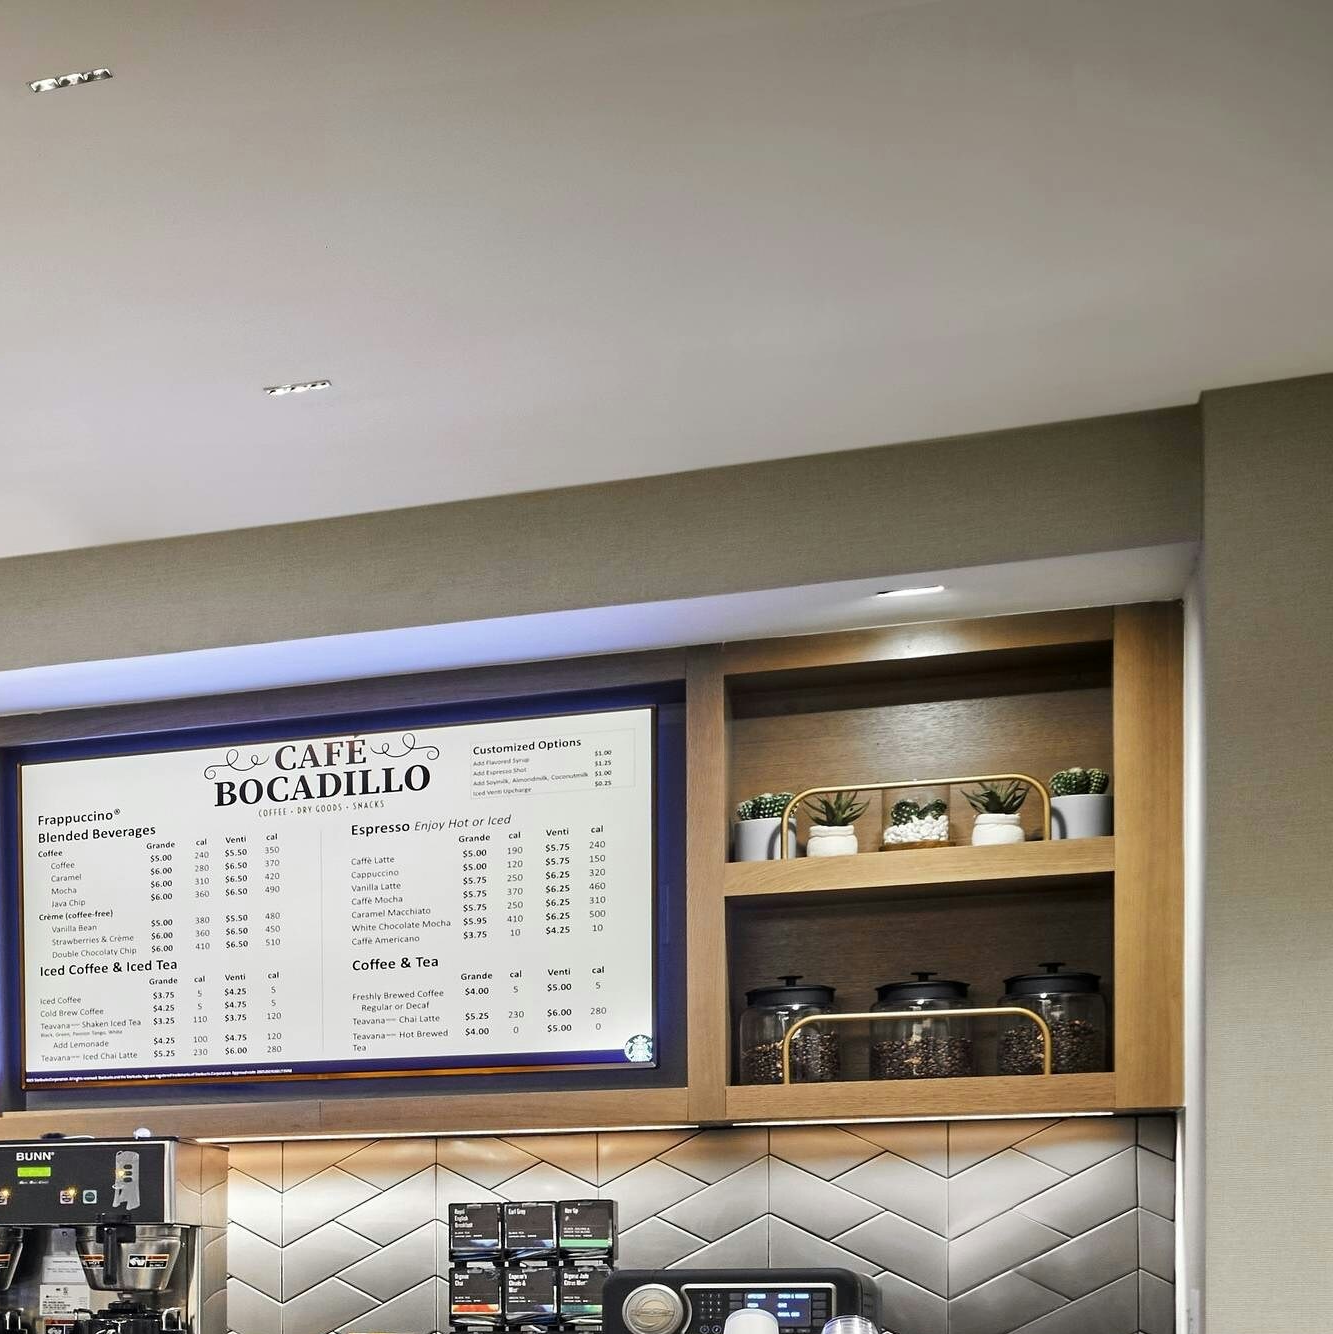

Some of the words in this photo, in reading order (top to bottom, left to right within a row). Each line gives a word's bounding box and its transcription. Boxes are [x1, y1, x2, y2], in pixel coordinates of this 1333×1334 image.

[473, 741, 535, 755] Customized
[538, 739, 582, 751] Options
[214, 764, 431, 807] BOCADILLO
[258, 807, 286, 818] COFFEE
[297, 806, 312, 814] DRY
[315, 803, 342, 813] GOODS
[352, 799, 384, 810] SNACKS
[38, 829, 89, 844] Blended
[92, 826, 156, 839] Beverages
[351, 823, 410, 837] Espresso
[414, 821, 445, 832] Enjoy
[448, 819, 469, 828] Hot
[472, 819, 484, 827] or
[487, 814, 512, 825] Iced
[458, 834, 491, 843] Grande
[508, 831, 521, 839] cal
[546, 827, 569, 837] Venti
[590, 825, 604, 833] cal
[37, 849, 63, 858] Coffee
[146, 841, 175, 850] Grande
[195, 838, 207, 846] cal
[225, 836, 247, 844] Venti
[266, 833, 278, 841] cal
[351, 857, 372, 866] Caffè
[374, 856, 395, 864] Latte
[462, 849, 487, 858] $5.00
[507, 846, 523, 855] 190
[545, 843, 570, 853] $5.75
[589, 840, 606, 849] 240
[50, 873, 82, 883] Caramel
[150, 867, 173, 876] $6.00
[195, 864, 210, 873] 280
[225, 861, 248, 871] $6.50
[265, 859, 280, 868] 370
[351, 870, 399, 880] Cappuccino
[463, 862, 487, 872] $5.00
[507, 860, 524, 869] 120
[545, 857, 570, 866] $5.75
[590, 854, 606, 863] 150
[351, 883, 379, 892] Vanilla
[380, 883, 401, 891] Latte
[463, 876, 487, 886] $5.75
[507, 873, 524, 882] 250
[545, 870, 570, 880] $6.25
[589, 868, 606, 877] 320
[38, 913, 64, 921] Crème
[65, 909, 114, 921] (coffee-free)
[351, 909, 386, 919] Caramel
[387, 908, 431, 916] Macchiato
[463, 903, 487, 913] $5.75
[507, 900, 524, 910] 250
[545, 898, 570, 908] $6.25
[589, 896, 606, 905] 310
[51, 925, 77, 933] Vanilla
[78, 924, 97, 932] Bean
[151, 919, 173, 928] $5.00
[195, 916, 210, 925] 380
[225, 914, 248, 923] $5.50
[265, 911, 280, 920] 480
[40, 965, 65, 977] Iced
[68, 963, 109, 975] Coffee
[126, 960, 152, 972] Iced
[156, 959, 177, 970] Tea
[352, 958, 396, 971] Coffee
[415, 956, 439, 968] Tea
[40, 997, 56, 1005] Iced
[57, 996, 82, 1004] Coffee
[152, 991, 175, 1000] $3.75
[197, 989, 203, 998] 5
[224, 987, 247, 997] $4.25
[271, 985, 276, 994] 5
[361, 1003, 393, 1013] Regular
[406, 1001, 429, 1010] Decaf
